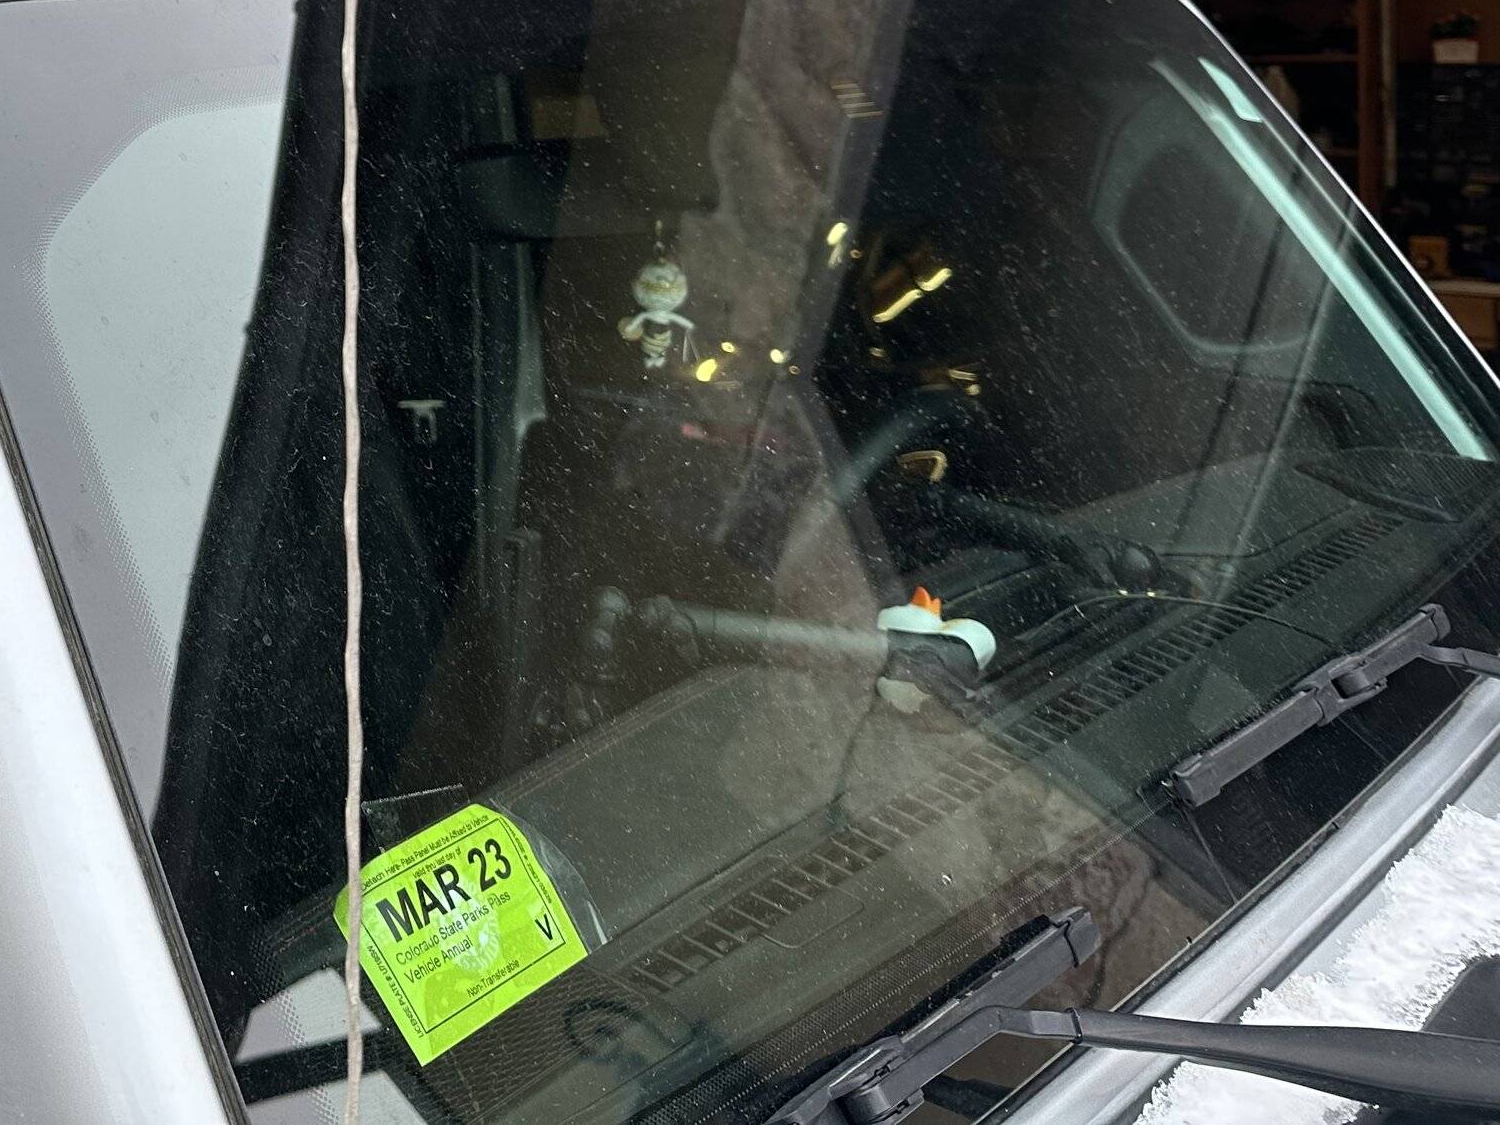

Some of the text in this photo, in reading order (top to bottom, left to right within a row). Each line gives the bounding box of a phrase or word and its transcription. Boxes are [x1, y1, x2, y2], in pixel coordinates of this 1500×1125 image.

[375, 863, 472, 943] MAR
[467, 838, 512, 892] 23
[395, 891, 511, 965] Colorado State Parks Pass
[534, 913, 554, 941] V
[404, 935, 474, 984] Vehicle Annual
[466, 959, 520, 998] Non-Transferable
[389, 982, 407, 1006] PLATE
[402, 1005, 424, 1038] LICENSE
